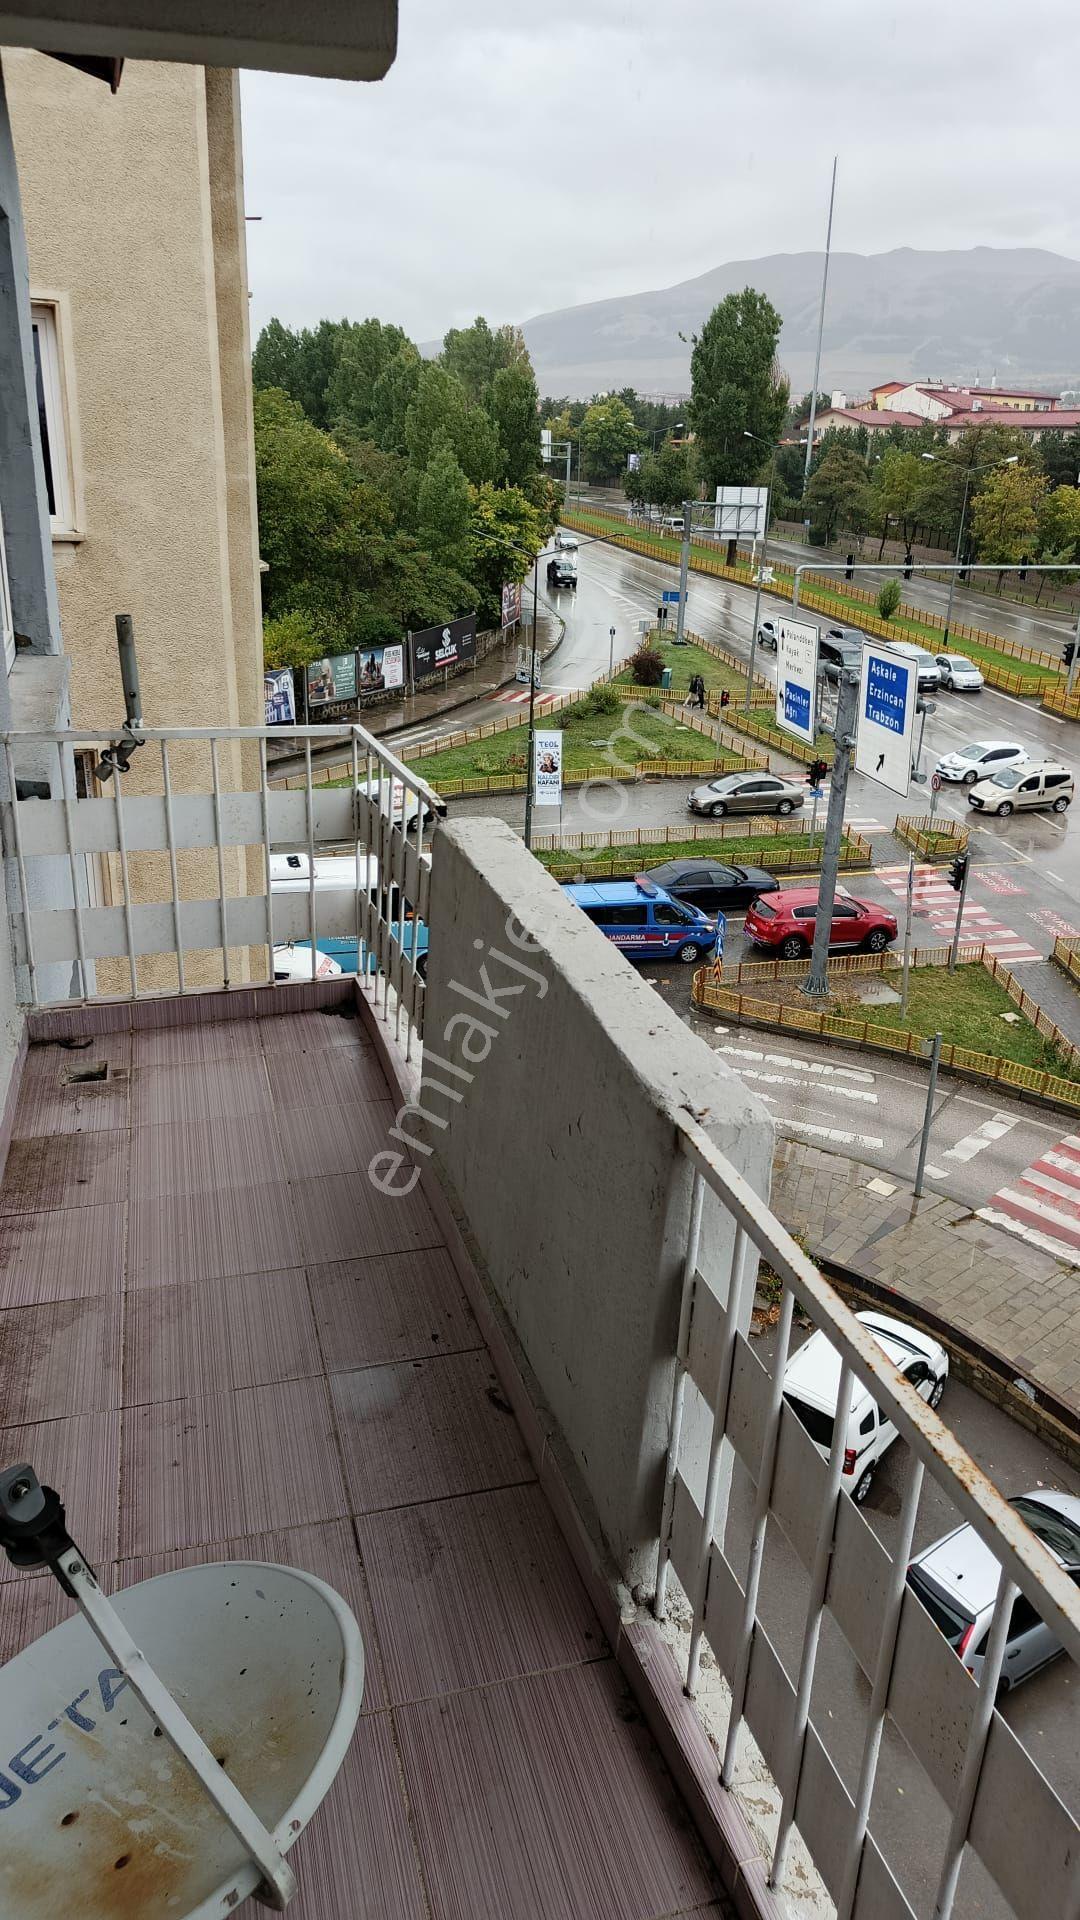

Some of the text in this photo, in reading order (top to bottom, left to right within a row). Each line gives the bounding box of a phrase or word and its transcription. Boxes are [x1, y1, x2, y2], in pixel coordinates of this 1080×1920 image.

[435, 643, 457, 660] SELÇUK
[871, 661, 897, 681] Aşkale
[786, 687, 809, 707] Pasinler
[869, 682, 904, 709] Erzincan
[868, 705, 900, 731] Trabzon
